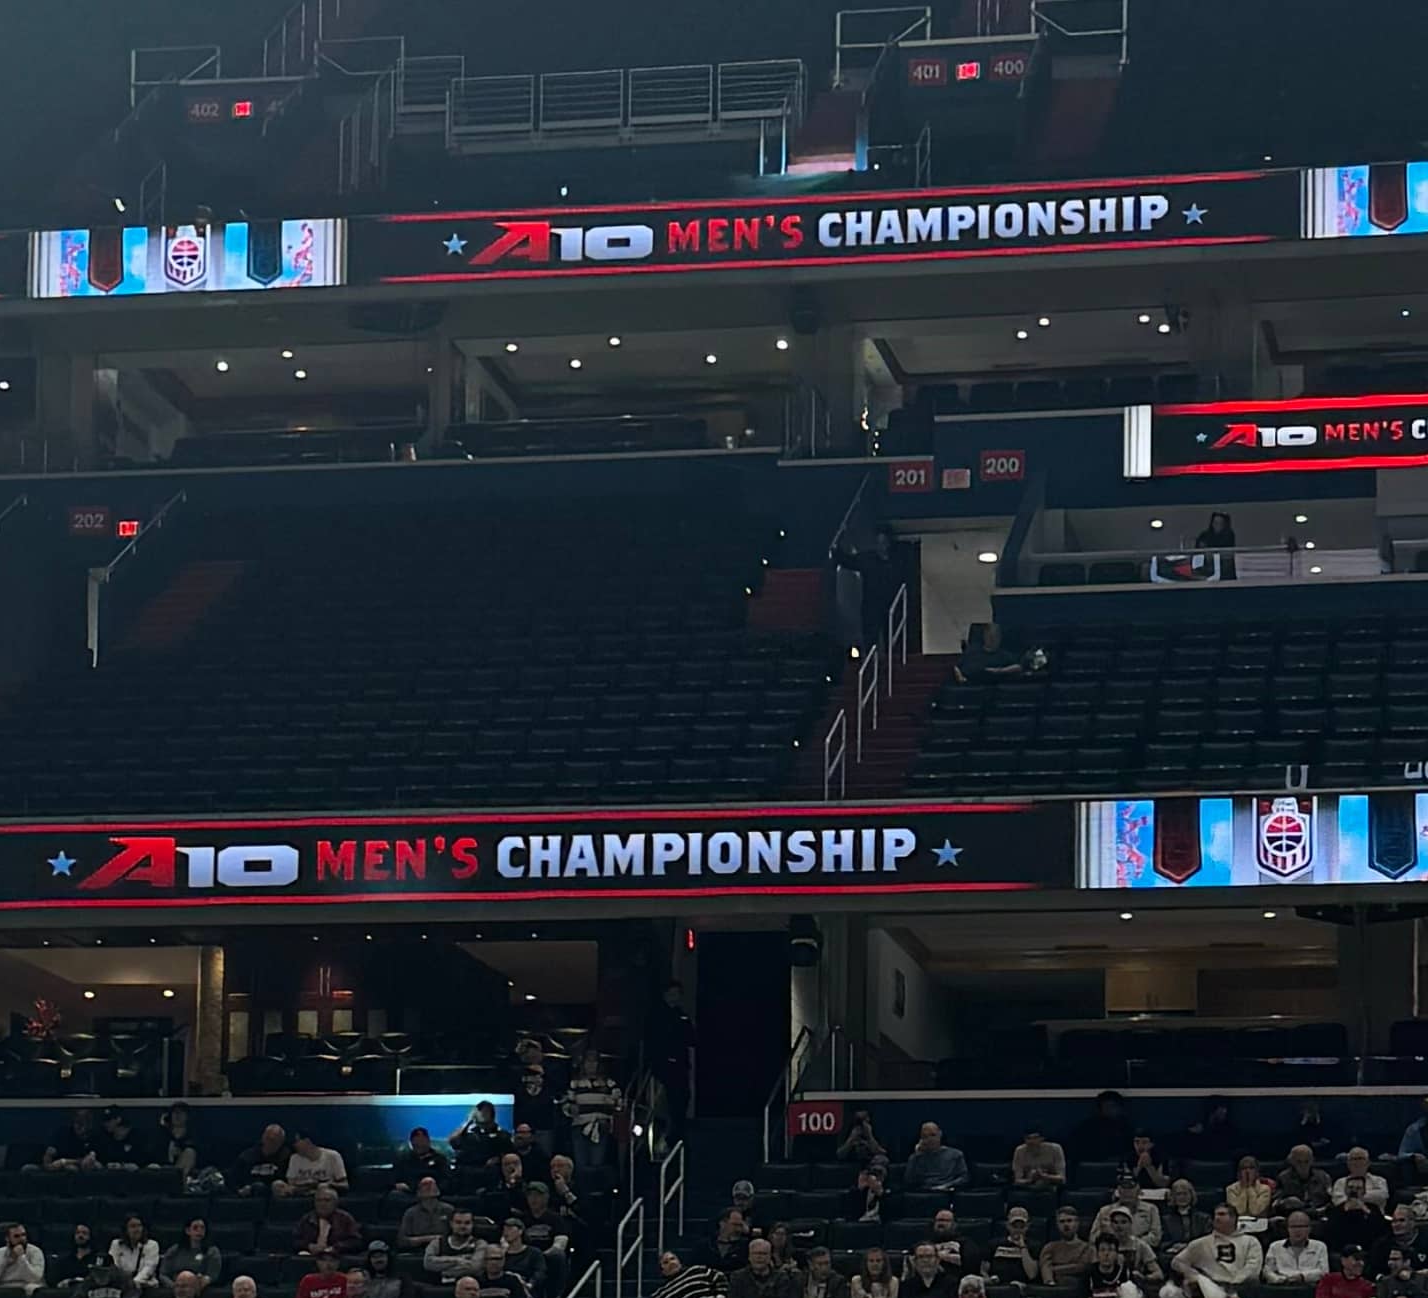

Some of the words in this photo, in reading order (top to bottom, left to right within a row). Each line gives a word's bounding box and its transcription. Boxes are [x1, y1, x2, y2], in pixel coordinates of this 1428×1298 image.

[469, 221, 654, 266] A10
[669, 216, 804, 252] MEN'S
[820, 197, 1169, 247] CHAMPIONSHIP
[1211, 424, 1317, 449] A10
[1326, 422, 1404, 441] MEN'S
[985, 457, 1020, 474] 200
[895, 469, 926, 487] 201
[75, 513, 104, 529] 202
[77, 837, 300, 889] A10
[318, 837, 478, 881] MEN'S
[499, 830, 916, 878] CHAMPIONSHIP
[798, 1112, 835, 1132] 100
